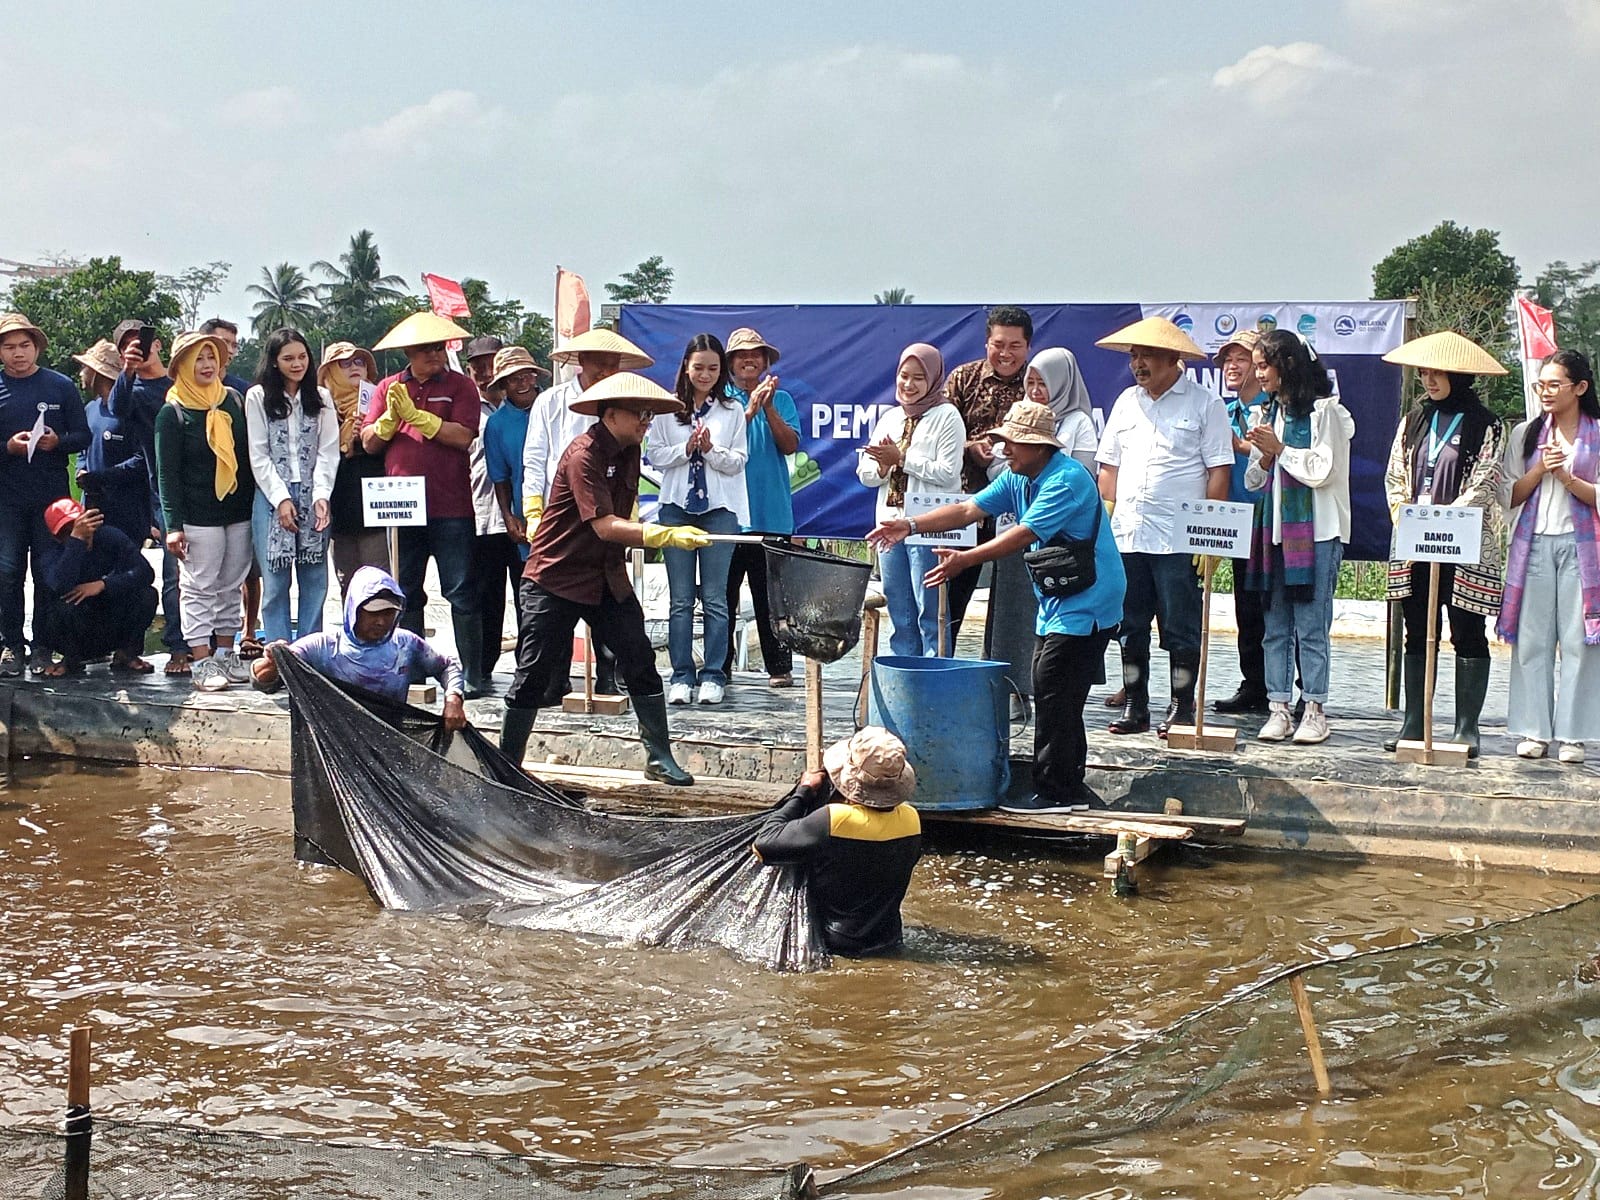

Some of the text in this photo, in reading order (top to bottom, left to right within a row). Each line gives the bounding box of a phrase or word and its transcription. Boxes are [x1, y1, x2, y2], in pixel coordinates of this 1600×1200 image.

[369, 500, 418, 510] KADISKOMINFO
[377, 511, 413, 520] BANYUMAS
[1186, 525, 1239, 538] KADISKANAK
[1424, 532, 1454, 542] BANOO
[1189, 537, 1234, 549] BANYUMAS
[1415, 543, 1461, 555] INDONESIA
